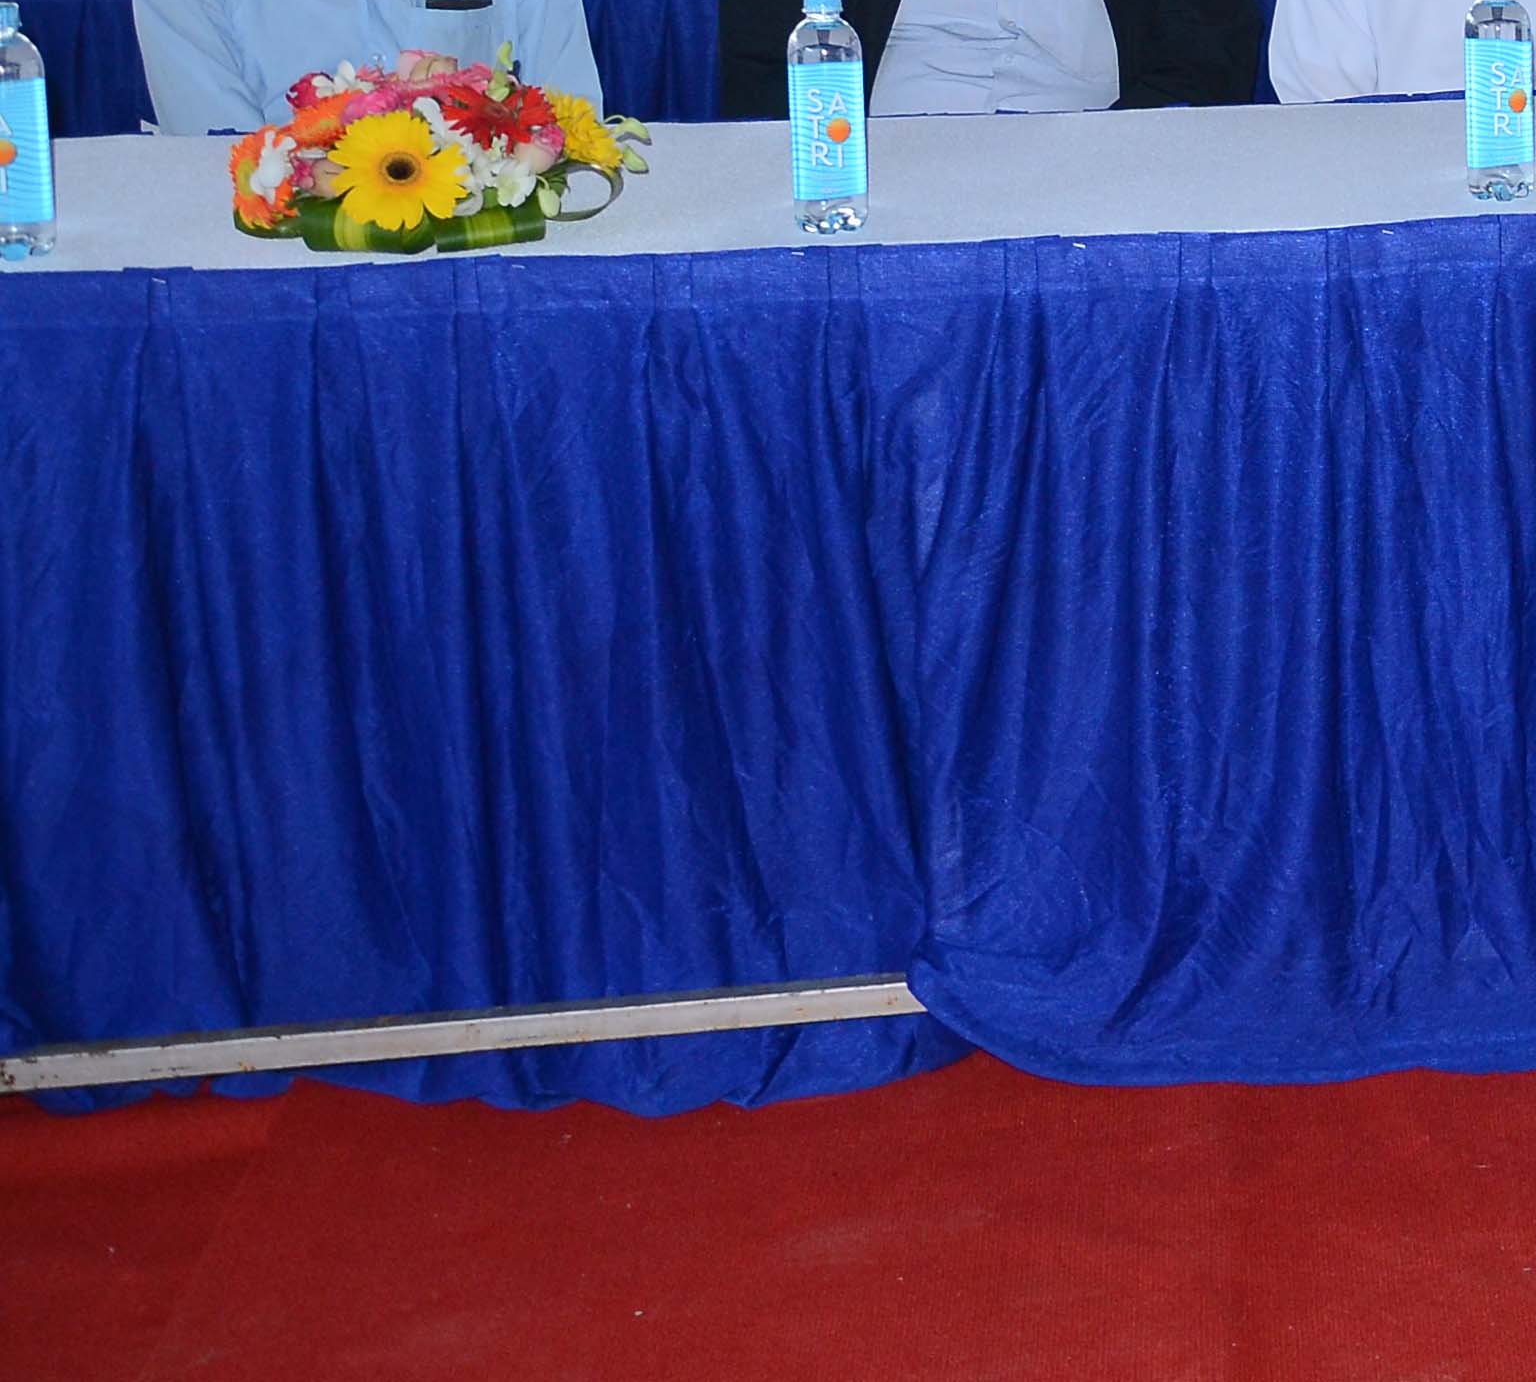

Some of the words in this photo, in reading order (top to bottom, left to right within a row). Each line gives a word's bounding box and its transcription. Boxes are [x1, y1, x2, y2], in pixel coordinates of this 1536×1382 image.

[1490, 61, 1524, 86] SA
[806, 87, 849, 115] SA
[1492, 113, 1522, 138] RI
[810, 142, 844, 169] RI
